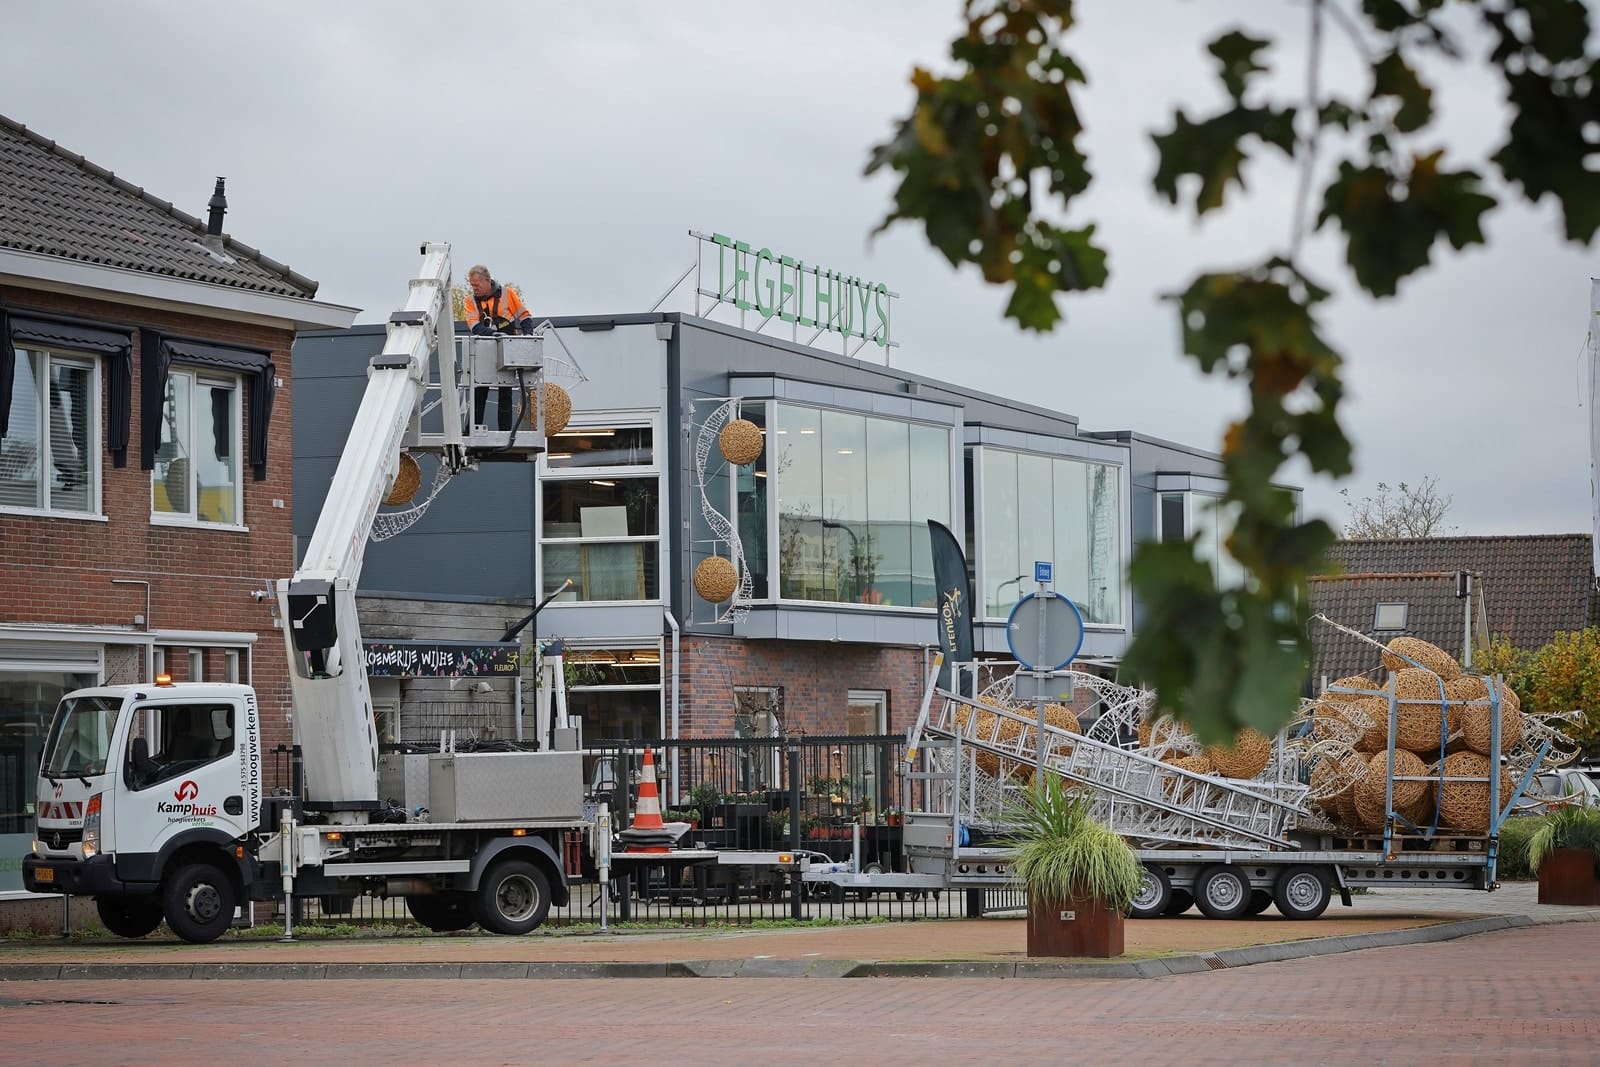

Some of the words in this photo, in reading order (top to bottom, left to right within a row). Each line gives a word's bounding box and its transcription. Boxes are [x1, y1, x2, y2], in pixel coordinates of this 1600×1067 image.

[713, 233, 888, 347] TEGELHUYS
[364, 649, 418, 670] LOEMERIJE
[421, 650, 454, 671] WIJHE
[494, 664, 515, 672] FLEUROP
[244, 694, 259, 823] www.hoogwerken.nl
[157, 801, 217, 816] Kamphuis
